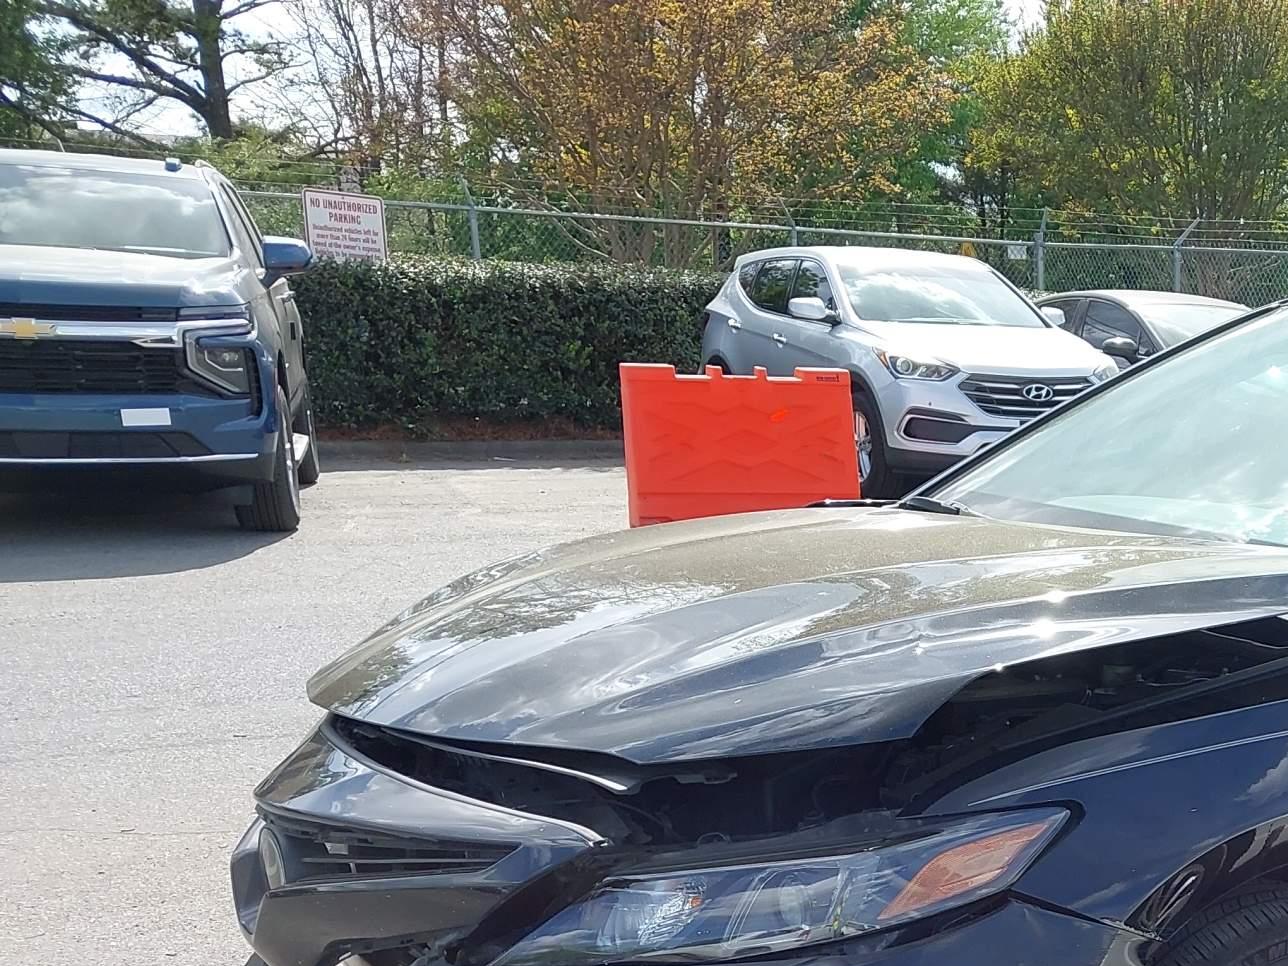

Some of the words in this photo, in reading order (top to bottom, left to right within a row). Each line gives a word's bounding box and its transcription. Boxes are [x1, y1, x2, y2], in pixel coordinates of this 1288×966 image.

[310, 198, 320, 208] NO
[323, 200, 377, 214] UNAUTHORIZED
[329, 212, 361, 225] PARKING
